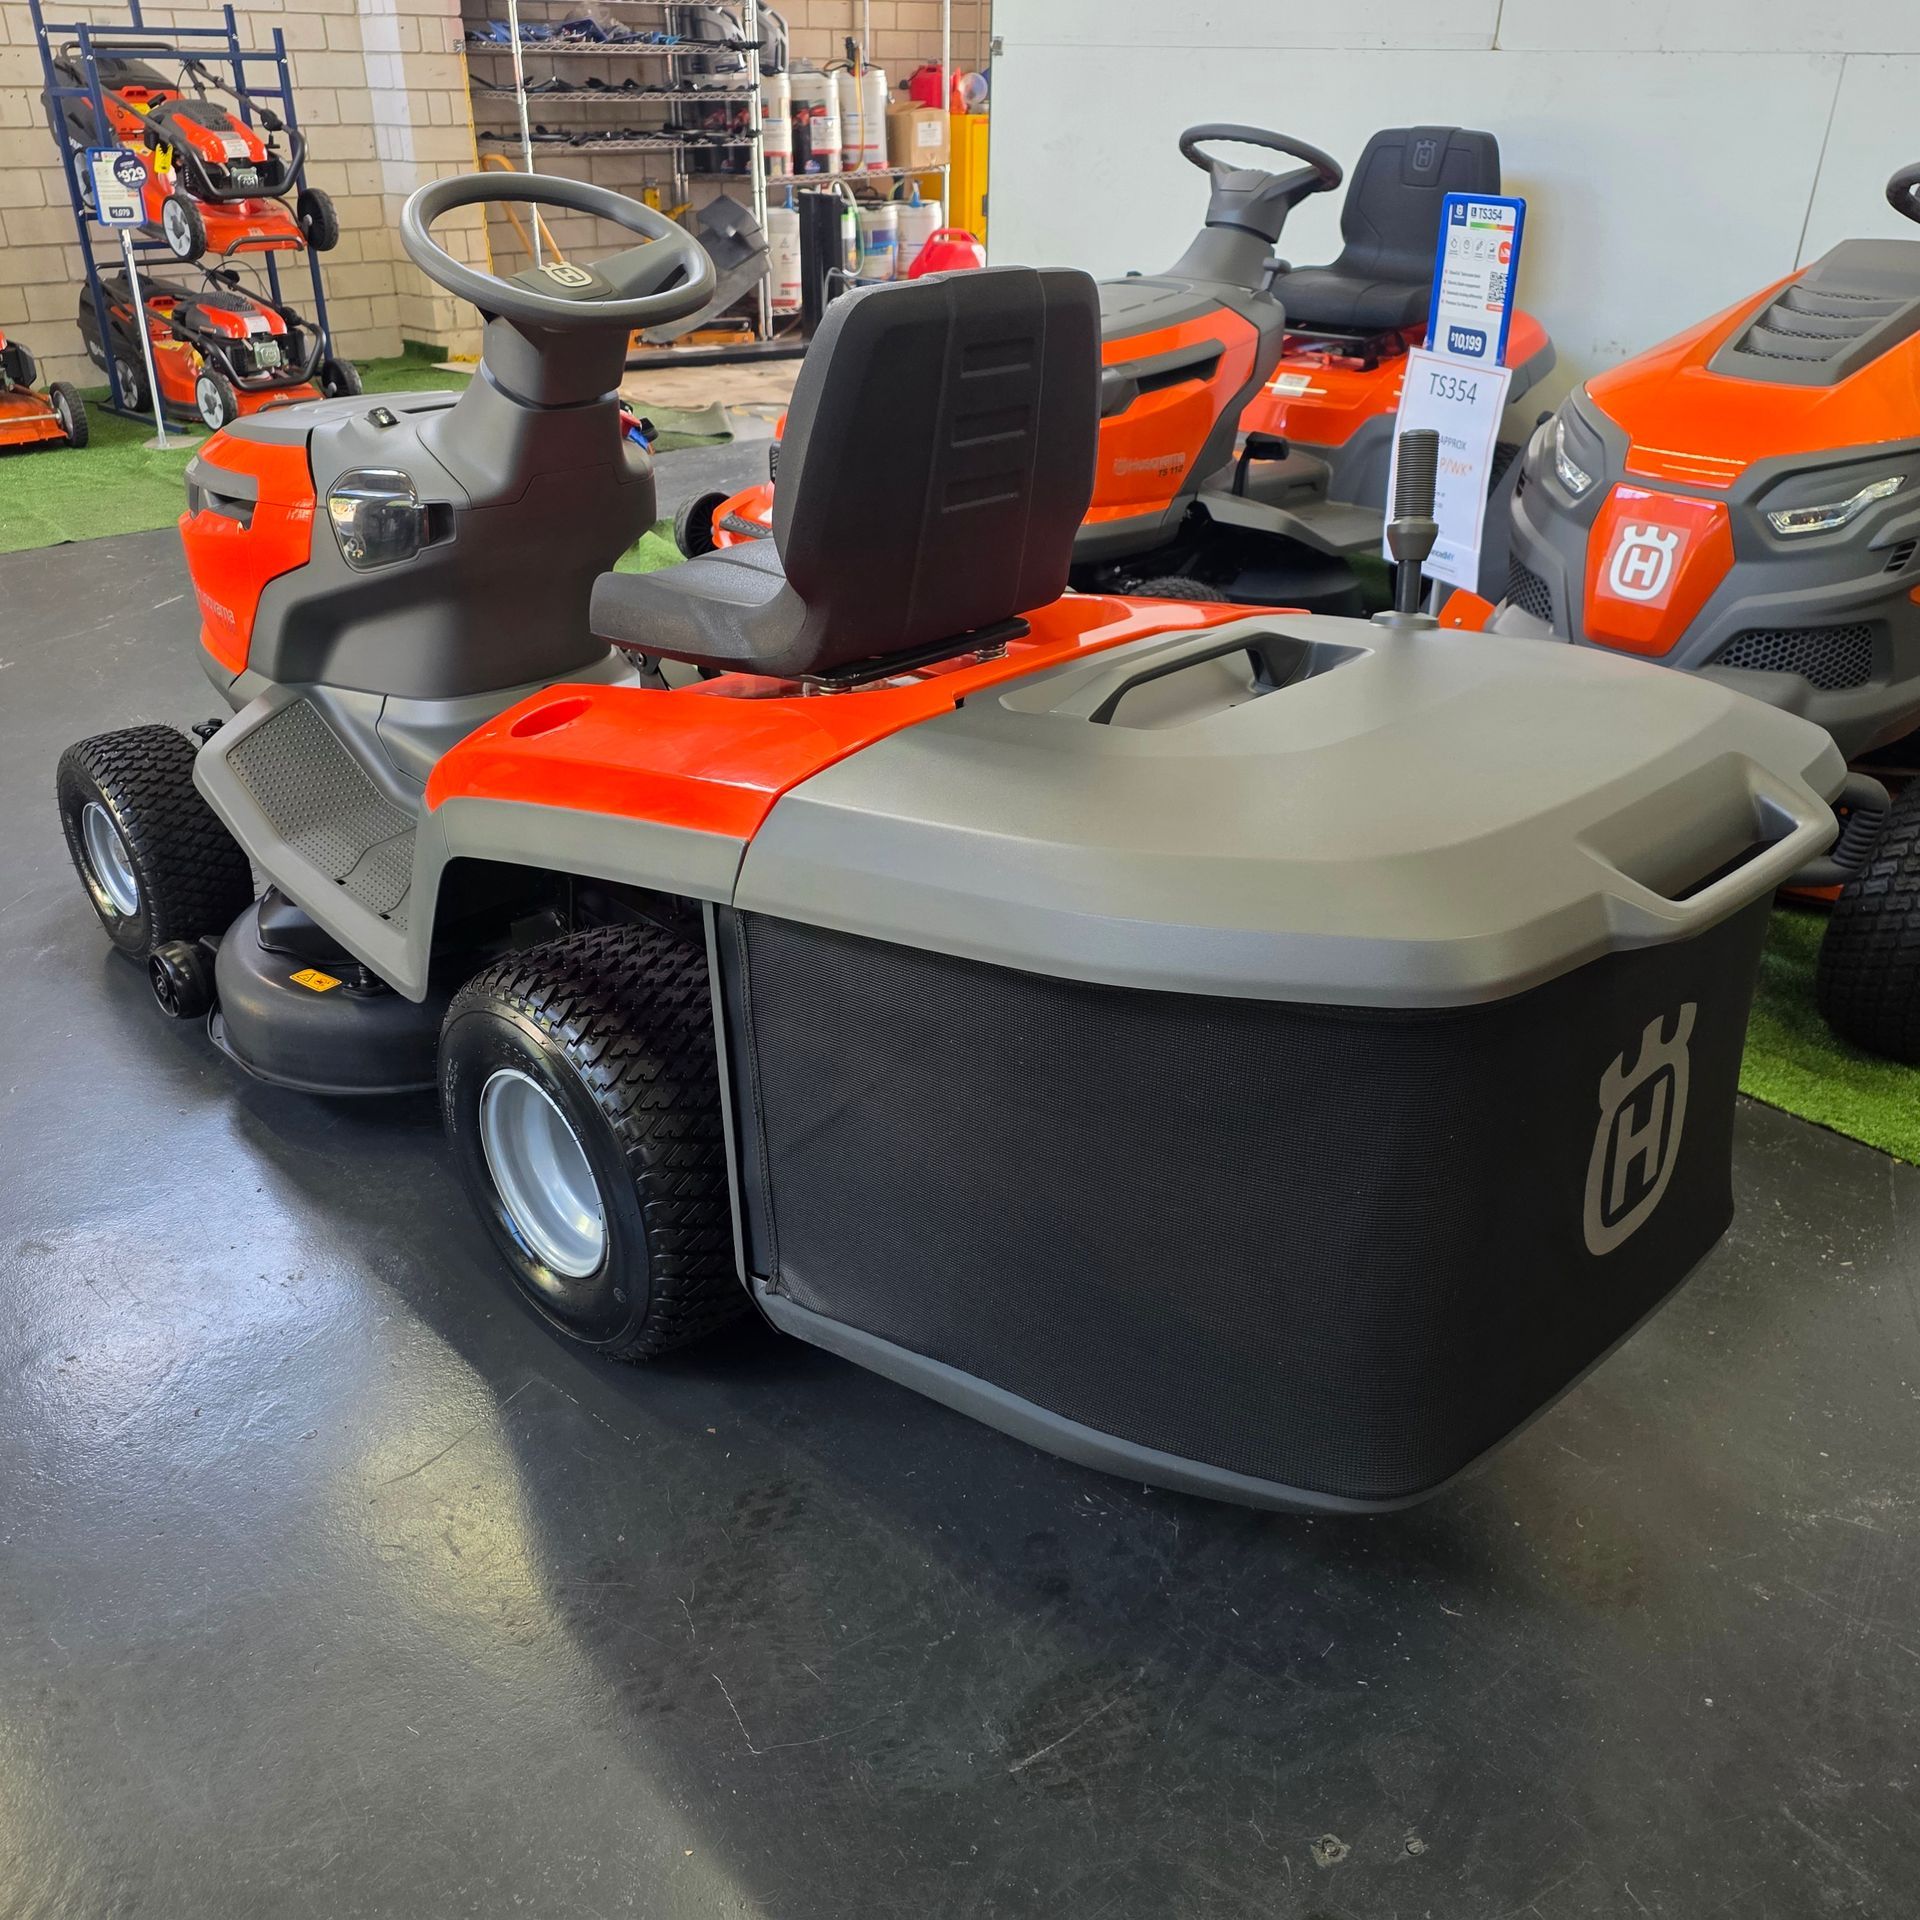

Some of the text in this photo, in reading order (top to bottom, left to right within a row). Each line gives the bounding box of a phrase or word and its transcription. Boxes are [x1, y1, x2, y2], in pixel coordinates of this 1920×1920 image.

[117, 166, 147, 183] $929
[1479, 207, 1503, 221] TS354
[1450, 332, 1483, 352] $10,199
[1430, 372, 1478, 405] TS354
